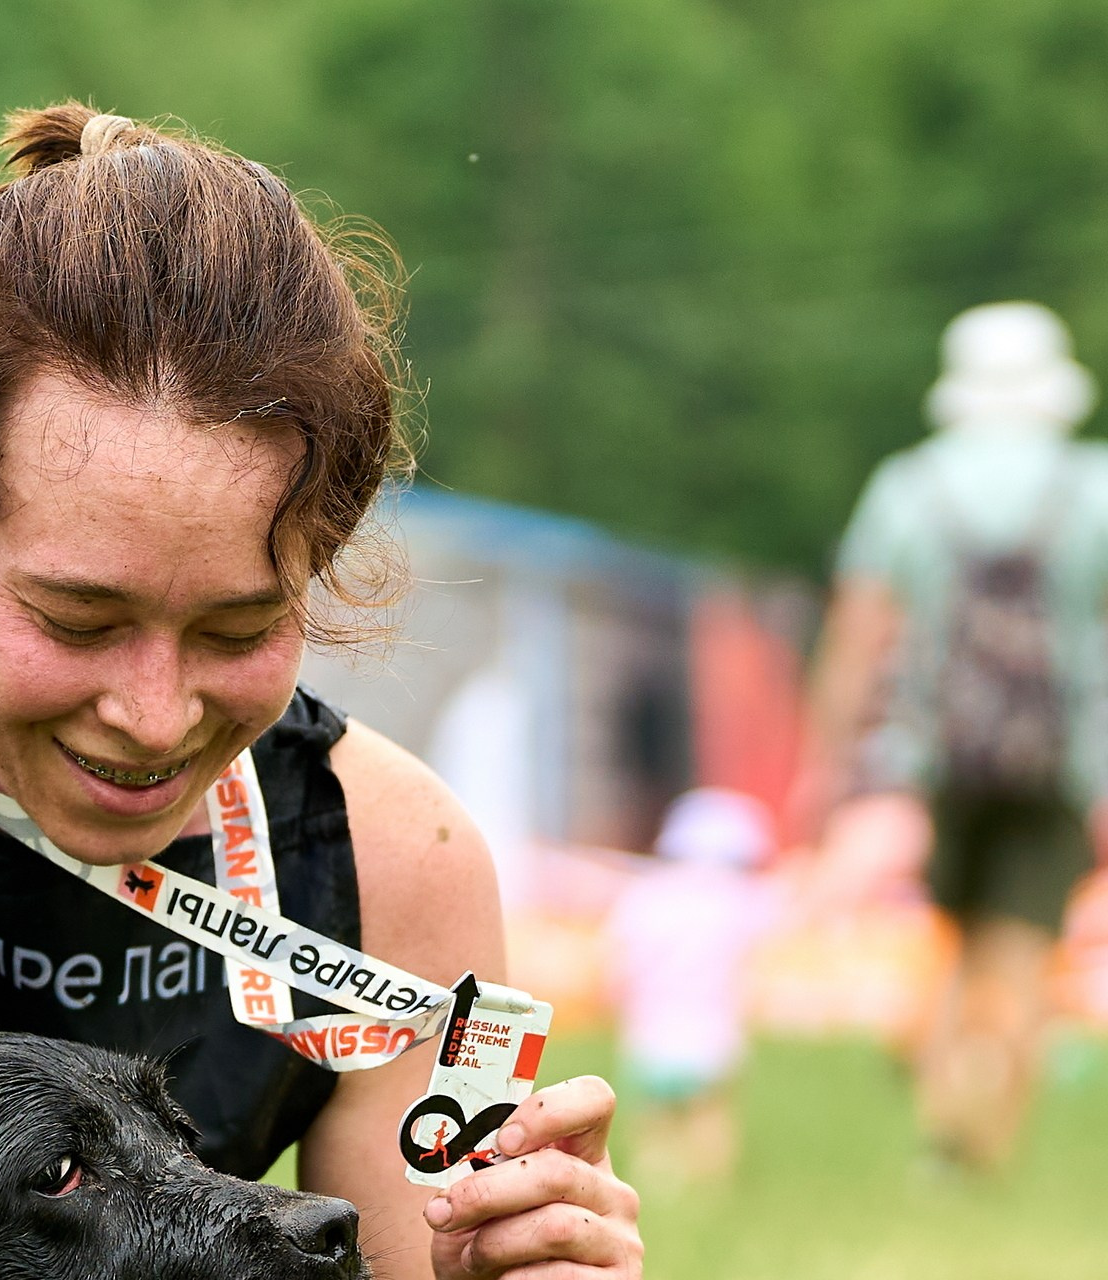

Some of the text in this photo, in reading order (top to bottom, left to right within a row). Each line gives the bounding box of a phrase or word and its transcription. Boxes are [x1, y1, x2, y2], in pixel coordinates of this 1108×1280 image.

[167, 888, 287, 960] лапы
[455, 1017, 511, 1036] RUSSIAN
[449, 1041, 476, 1055] DOG
[452, 1029, 511, 1048] EXTREME
[446, 1053, 481, 1069] TRAIL
